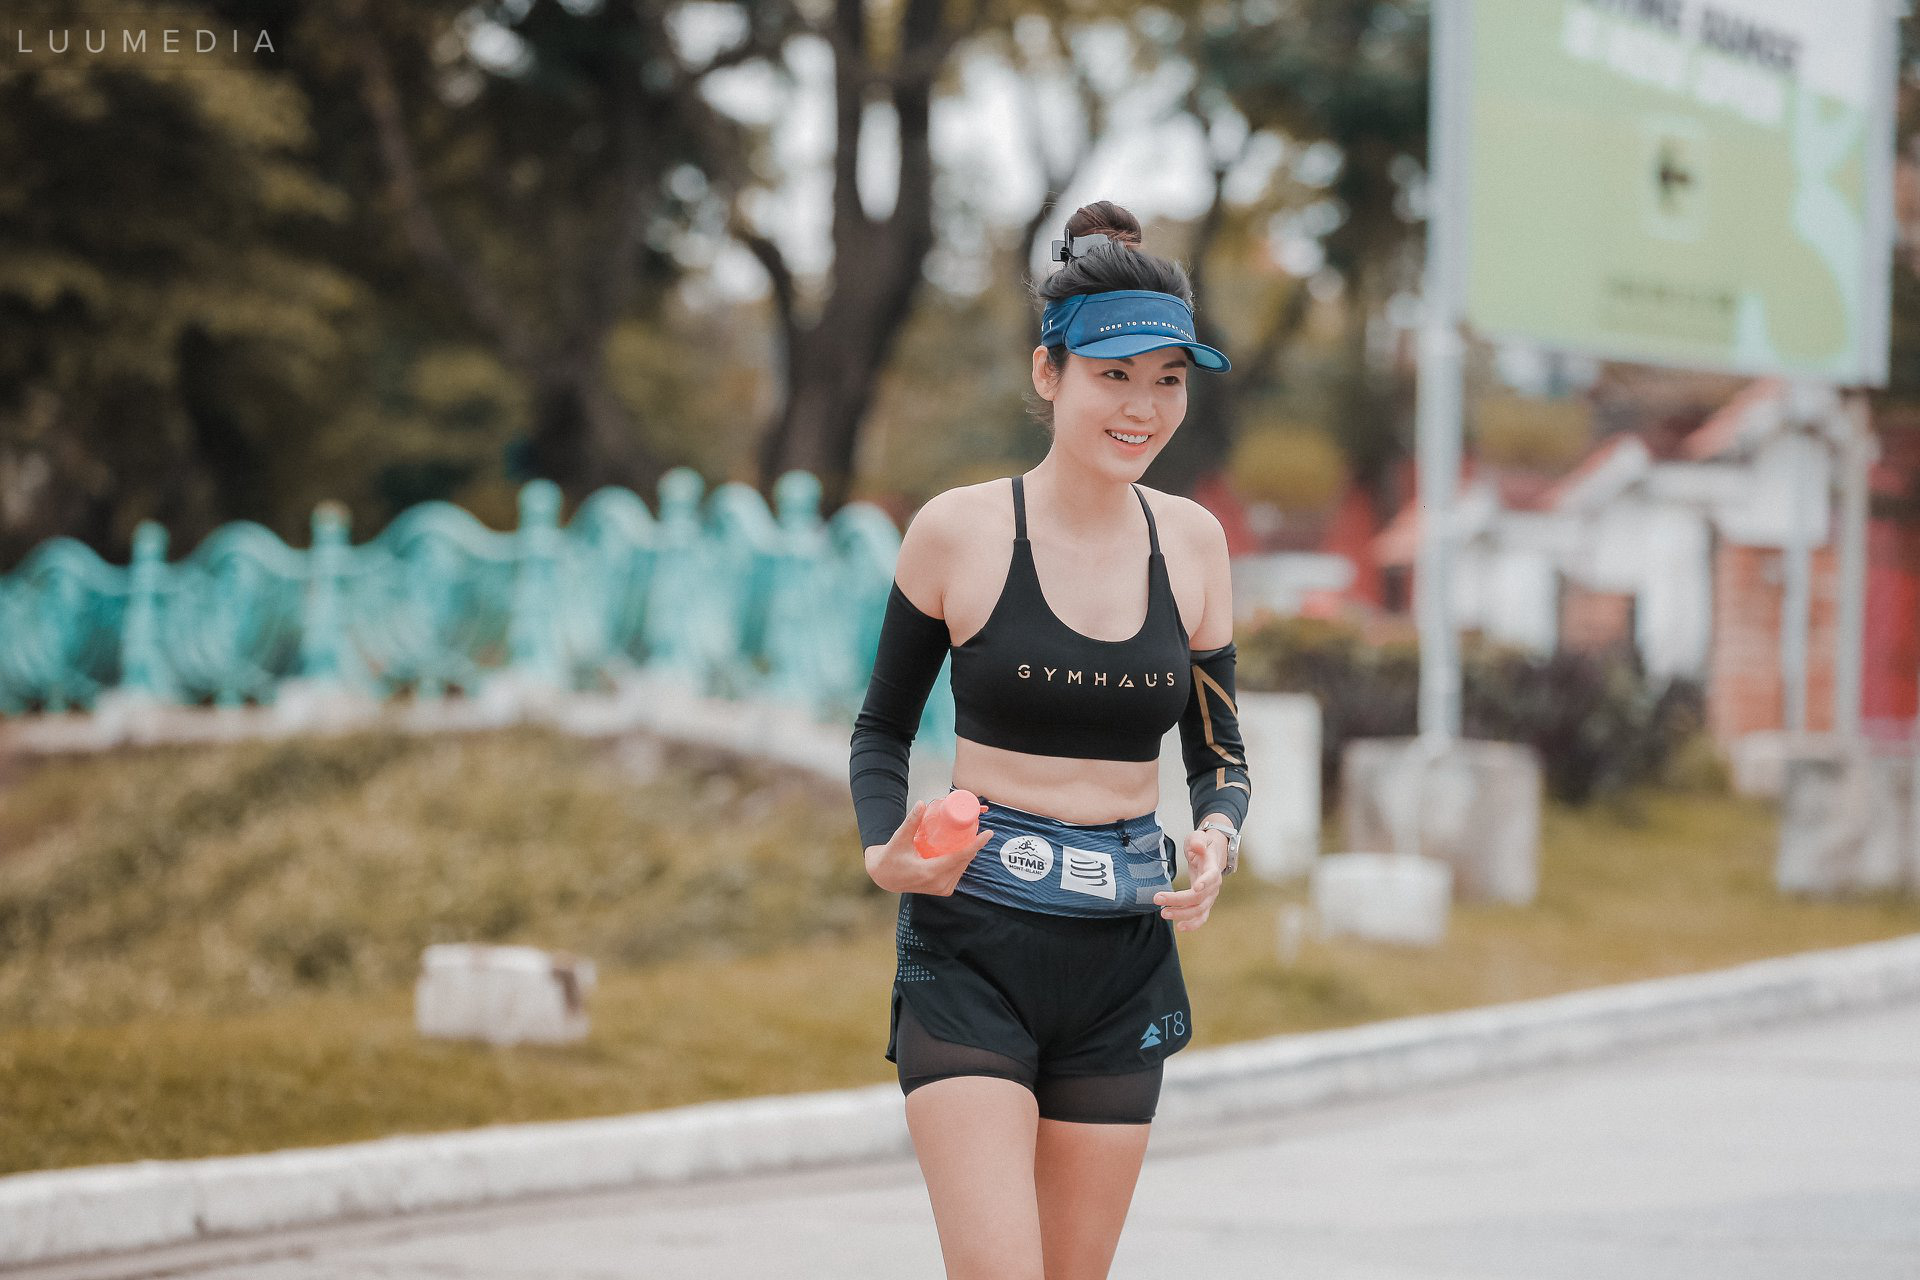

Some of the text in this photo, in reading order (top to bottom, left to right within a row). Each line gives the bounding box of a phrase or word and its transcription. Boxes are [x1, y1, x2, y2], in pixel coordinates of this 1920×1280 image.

[1100, 323, 1122, 332] BORN
[1017, 664, 1175, 688] GYMHAUS
[1008, 855, 1045, 870] UTMB
[1160, 1010, 1185, 1040] T8
